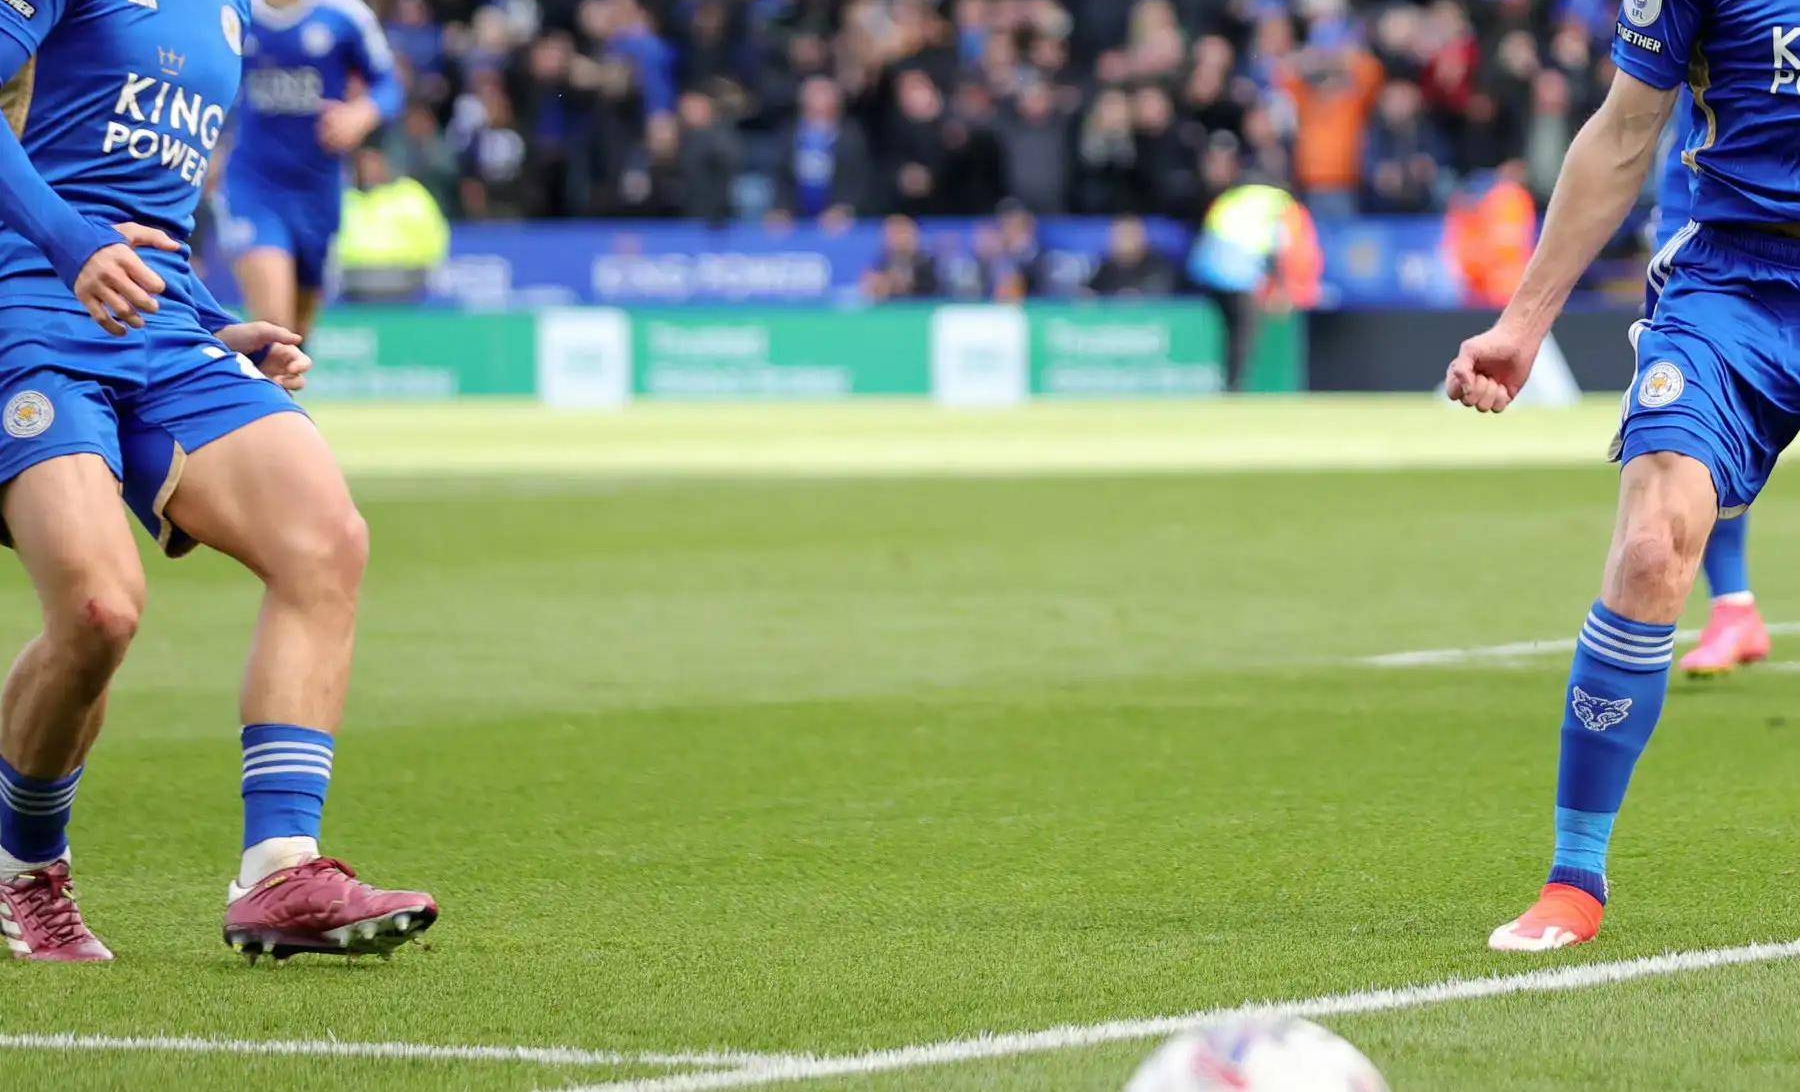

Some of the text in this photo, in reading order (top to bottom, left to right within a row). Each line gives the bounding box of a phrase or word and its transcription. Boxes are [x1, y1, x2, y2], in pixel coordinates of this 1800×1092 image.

[1616, 21, 1662, 53] TGETHER
[1631, 8, 1643, 20] EFL
[114, 72, 224, 150] KING
[102, 120, 209, 187] POWER
